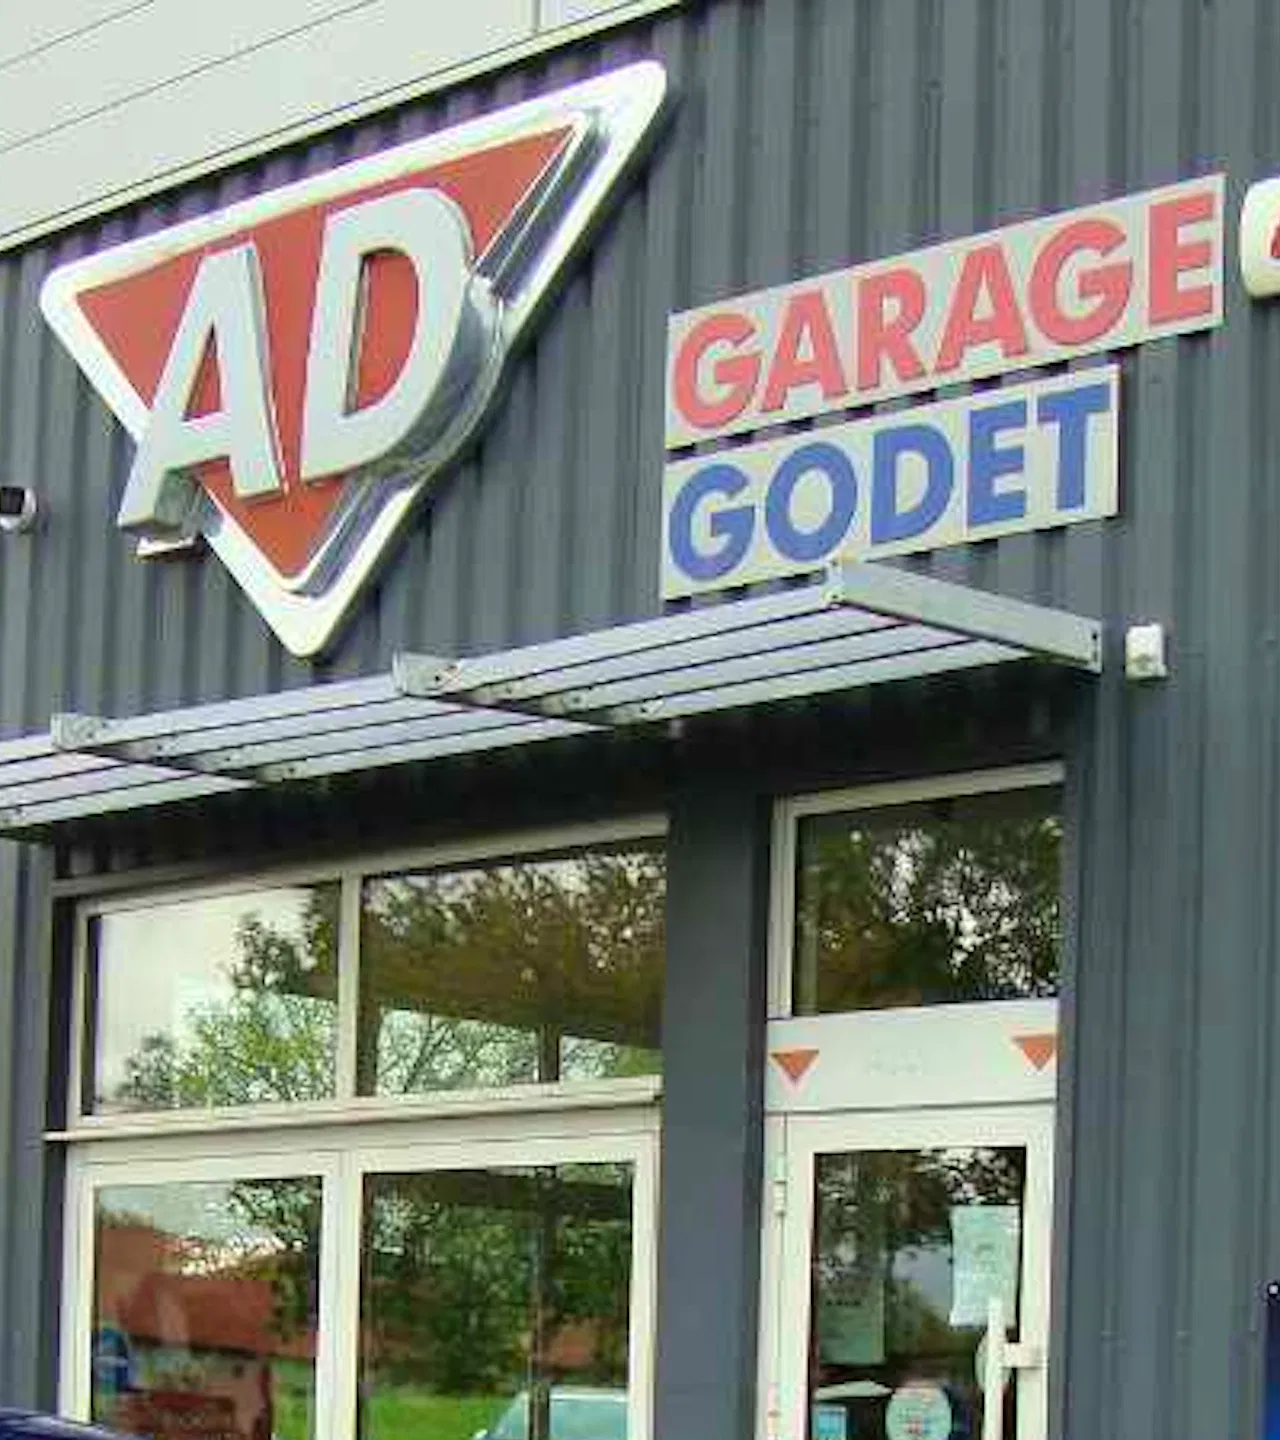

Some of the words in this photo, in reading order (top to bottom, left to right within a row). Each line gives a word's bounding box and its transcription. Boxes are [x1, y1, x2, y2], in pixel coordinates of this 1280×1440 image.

[117, 186, 476, 530] AD
[672, 189, 1216, 432] GARAGE
[668, 382, 1114, 583] GODET
